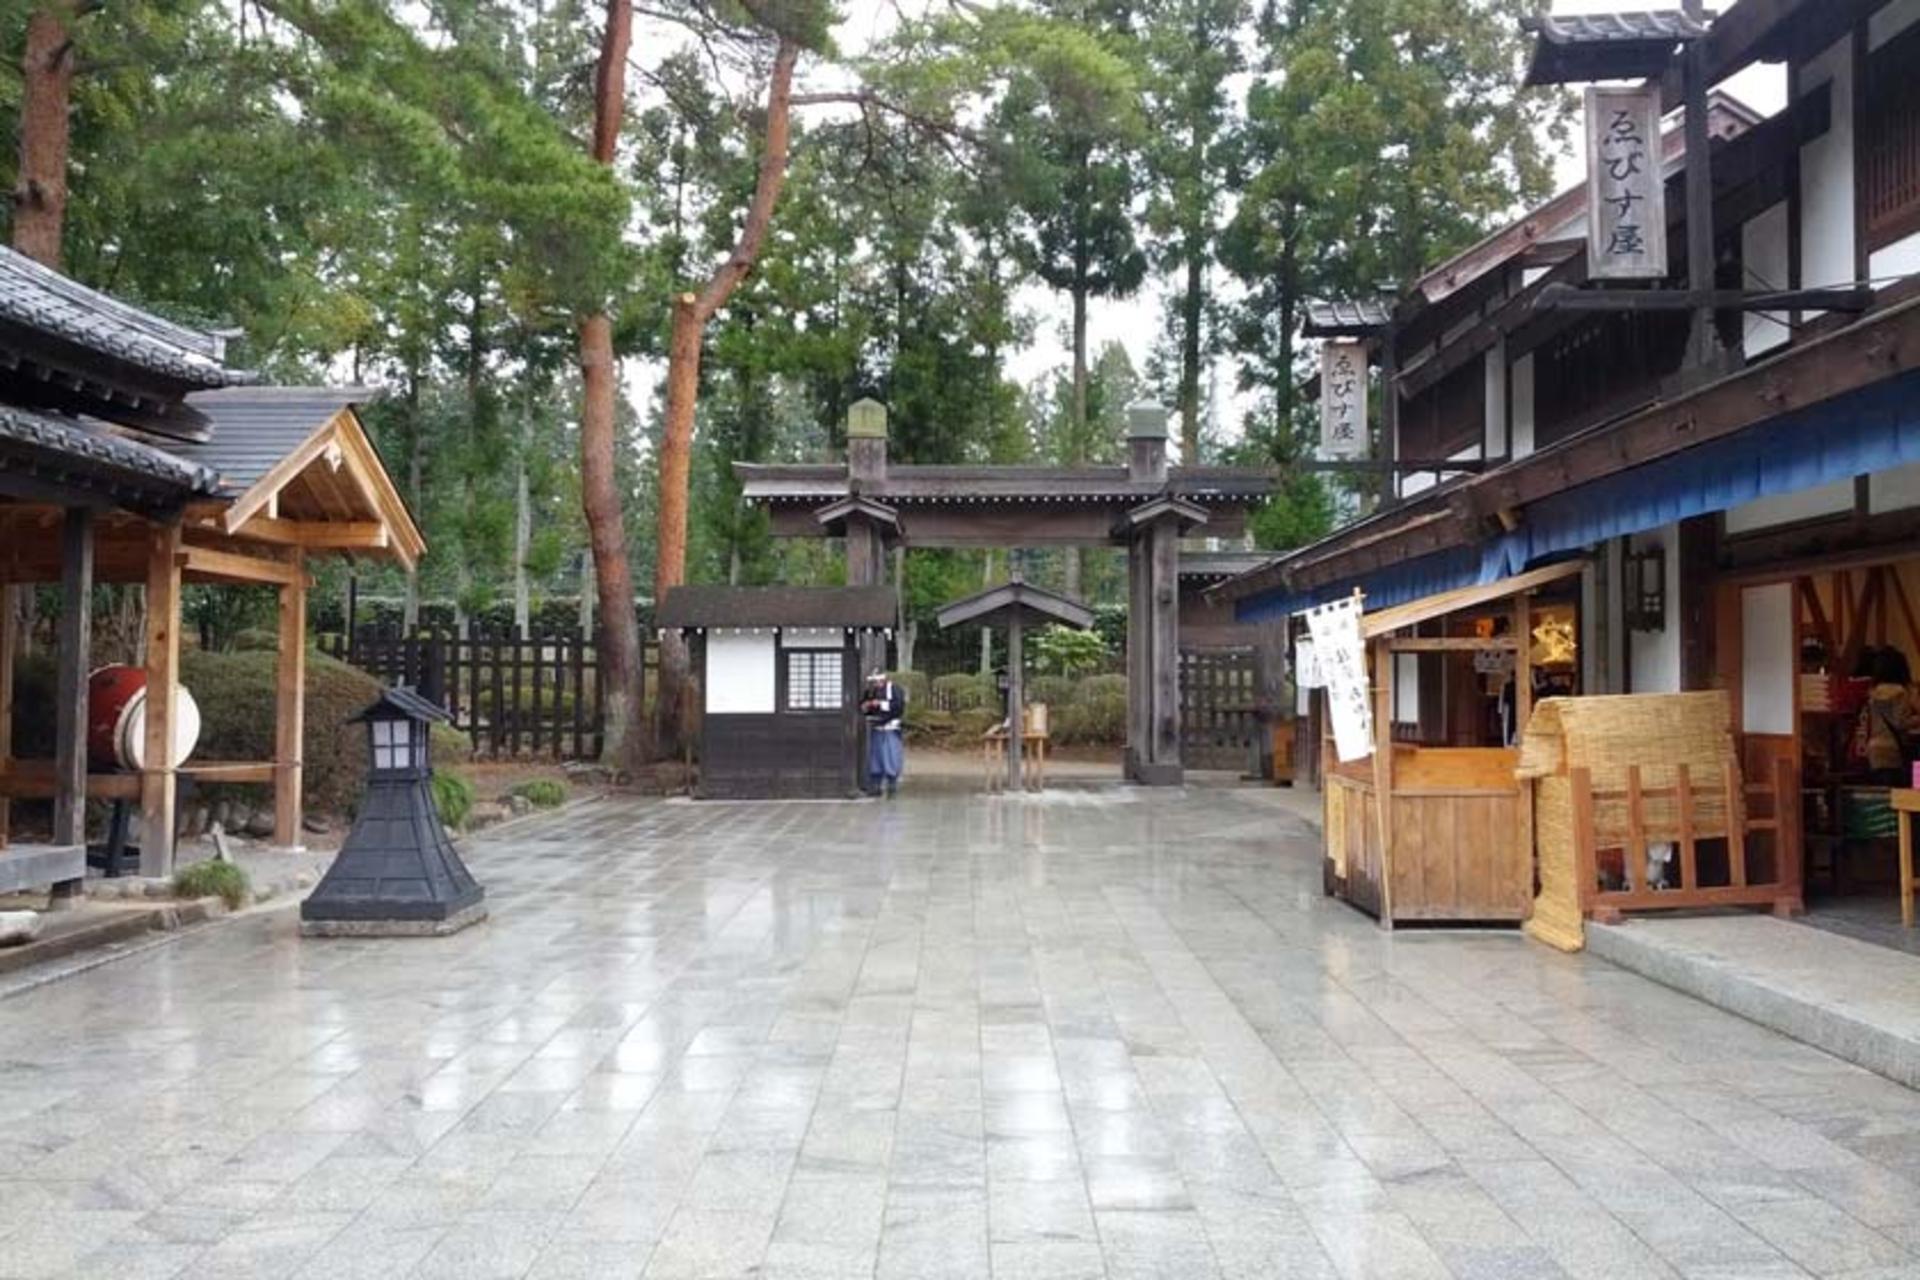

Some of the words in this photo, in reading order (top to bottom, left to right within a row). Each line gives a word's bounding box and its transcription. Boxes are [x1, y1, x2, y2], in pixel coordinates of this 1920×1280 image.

[1603, 111, 1645, 255] ゑびす屋
[1329, 355, 1356, 440] ゑびす屋
